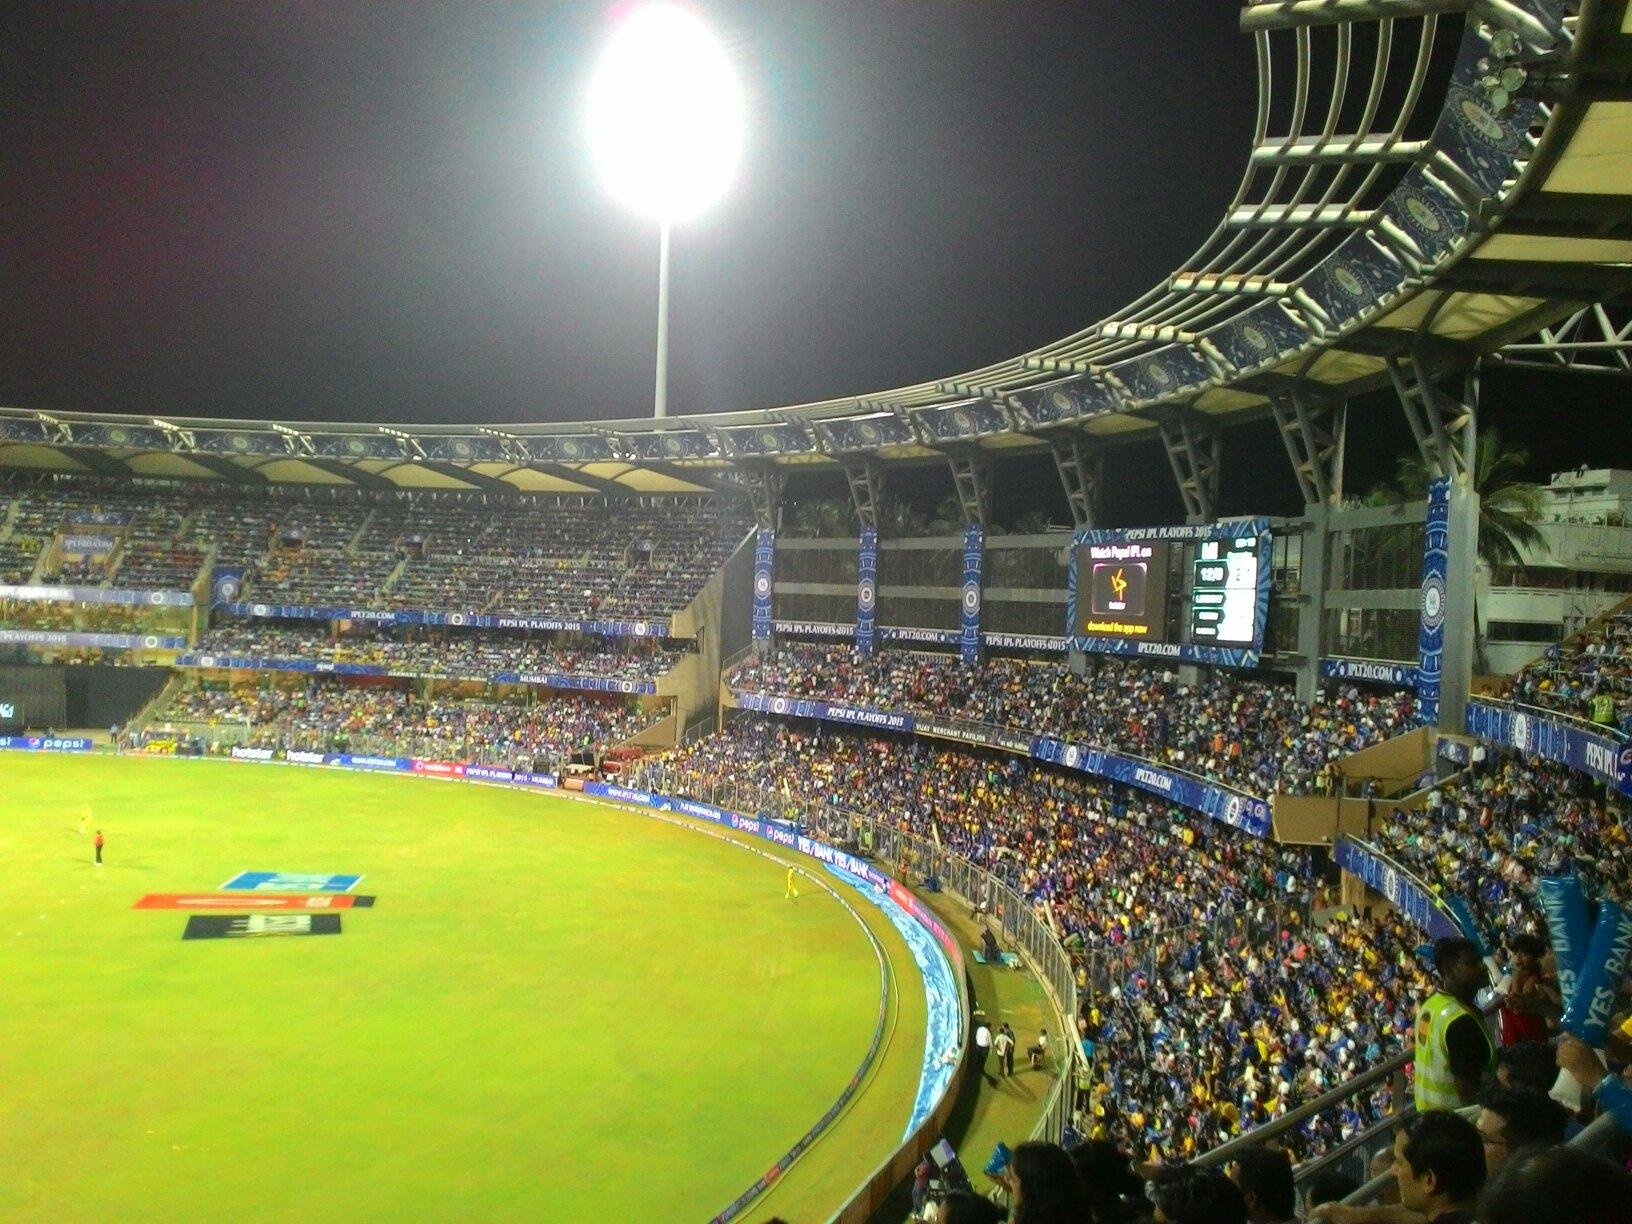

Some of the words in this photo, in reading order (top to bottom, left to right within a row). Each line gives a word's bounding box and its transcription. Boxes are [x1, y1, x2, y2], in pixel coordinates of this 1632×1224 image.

[1127, 529, 1146, 540] PEPSI
[1146, 528, 1158, 539] IPL
[1159, 527, 1194, 539] PLAYOFFS
[1195, 526, 1213, 537] 2015
[351, 611, 396, 620] IPLT20.COM
[499, 618, 518, 628] PEPSI
[518, 620, 529, 628] IPL
[530, 620, 562, 630] PLAYOFFS
[563, 622, 580, 631] 2015
[775, 623, 793, 633] PEPSI
[793, 624, 804, 633] IPL
[804, 625, 836, 636] PLAYOFFS
[899, 631, 938, 642] IPLT20.COM
[985, 635, 1003, 647] PEPSI
[1003, 637, 1014, 648] IPL
[1015, 638, 1047, 651] PLAYOFFS
[1137, 642, 1181, 657] IPLT20.COM
[519, 675, 548, 684] MUMBAI
[1348, 663, 1393, 682] IPLT20.COM
[827, 706, 845, 718] PEPSI
[845, 710, 856, 720] IPL
[857, 711, 888, 725] PLAYOFFS
[888, 716, 904, 727] 2015
[915, 723, 930, 732] VIJAY
[932, 725, 961, 737] MERCHANT
[962, 731, 986, 743] PAVILION
[43, 739, 85, 750] pepsi
[1586, 741, 1604, 771] PEPSI
[1135, 768, 1172, 791] IPLT20.COM
[739, 818, 760, 833] pepsi
[773, 829, 795, 845] pepsi
[1584, 986, 1615, 1027] YES
[1604, 911, 1632, 976] BANK
